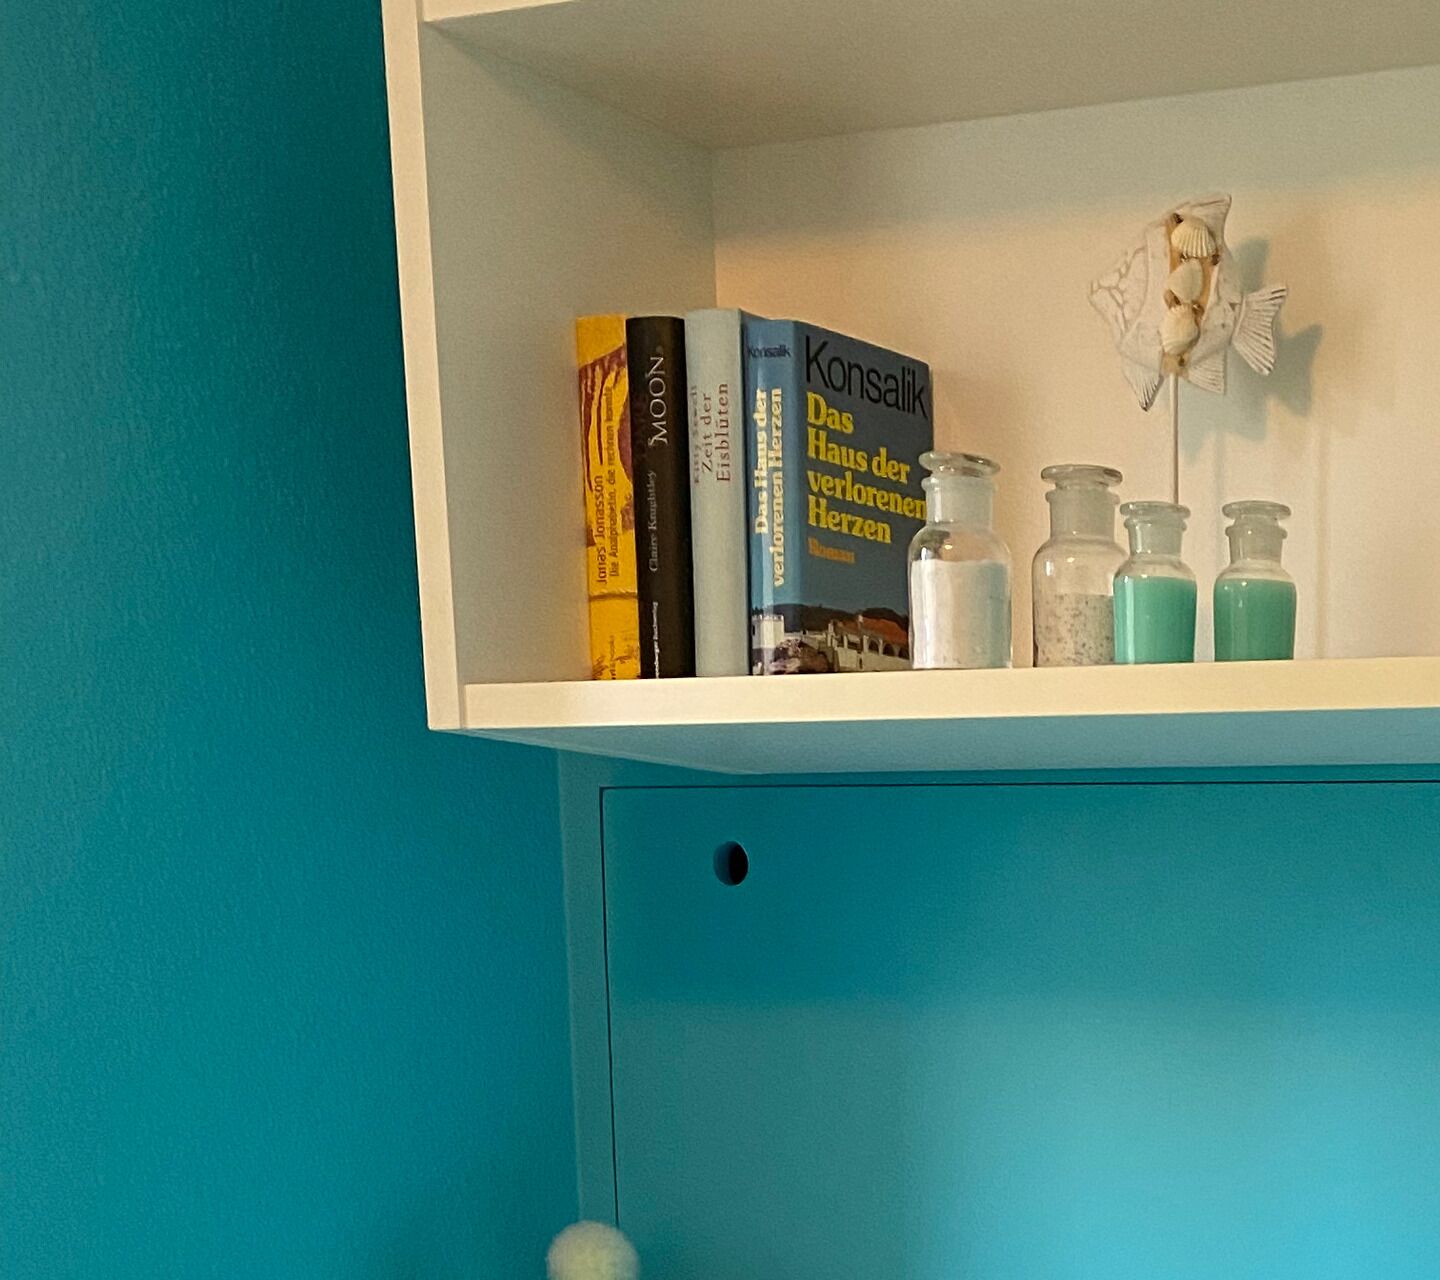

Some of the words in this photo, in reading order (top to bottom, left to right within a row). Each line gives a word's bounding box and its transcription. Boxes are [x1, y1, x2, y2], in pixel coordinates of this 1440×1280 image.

[749, 344, 791, 360] Konsalik
[804, 335, 929, 420] Konsalik
[645, 355, 669, 447] MOON
[701, 393, 713, 426] der
[753, 387, 767, 428] der
[806, 391, 855, 434] Das
[716, 383, 731, 482] Eisblüten
[768, 388, 783, 469] Herzen
[807, 427, 869, 473] Haus
[871, 447, 912, 484] der
[701, 440, 713, 473] Zeit
[754, 430, 768, 489] Haus
[592, 475, 606, 541] Jonasson
[755, 492, 768, 534] Das
[807, 470, 928, 521] verlorenen
[807, 494, 892, 544] Herzen
[769, 472, 785, 587] verlorenen
